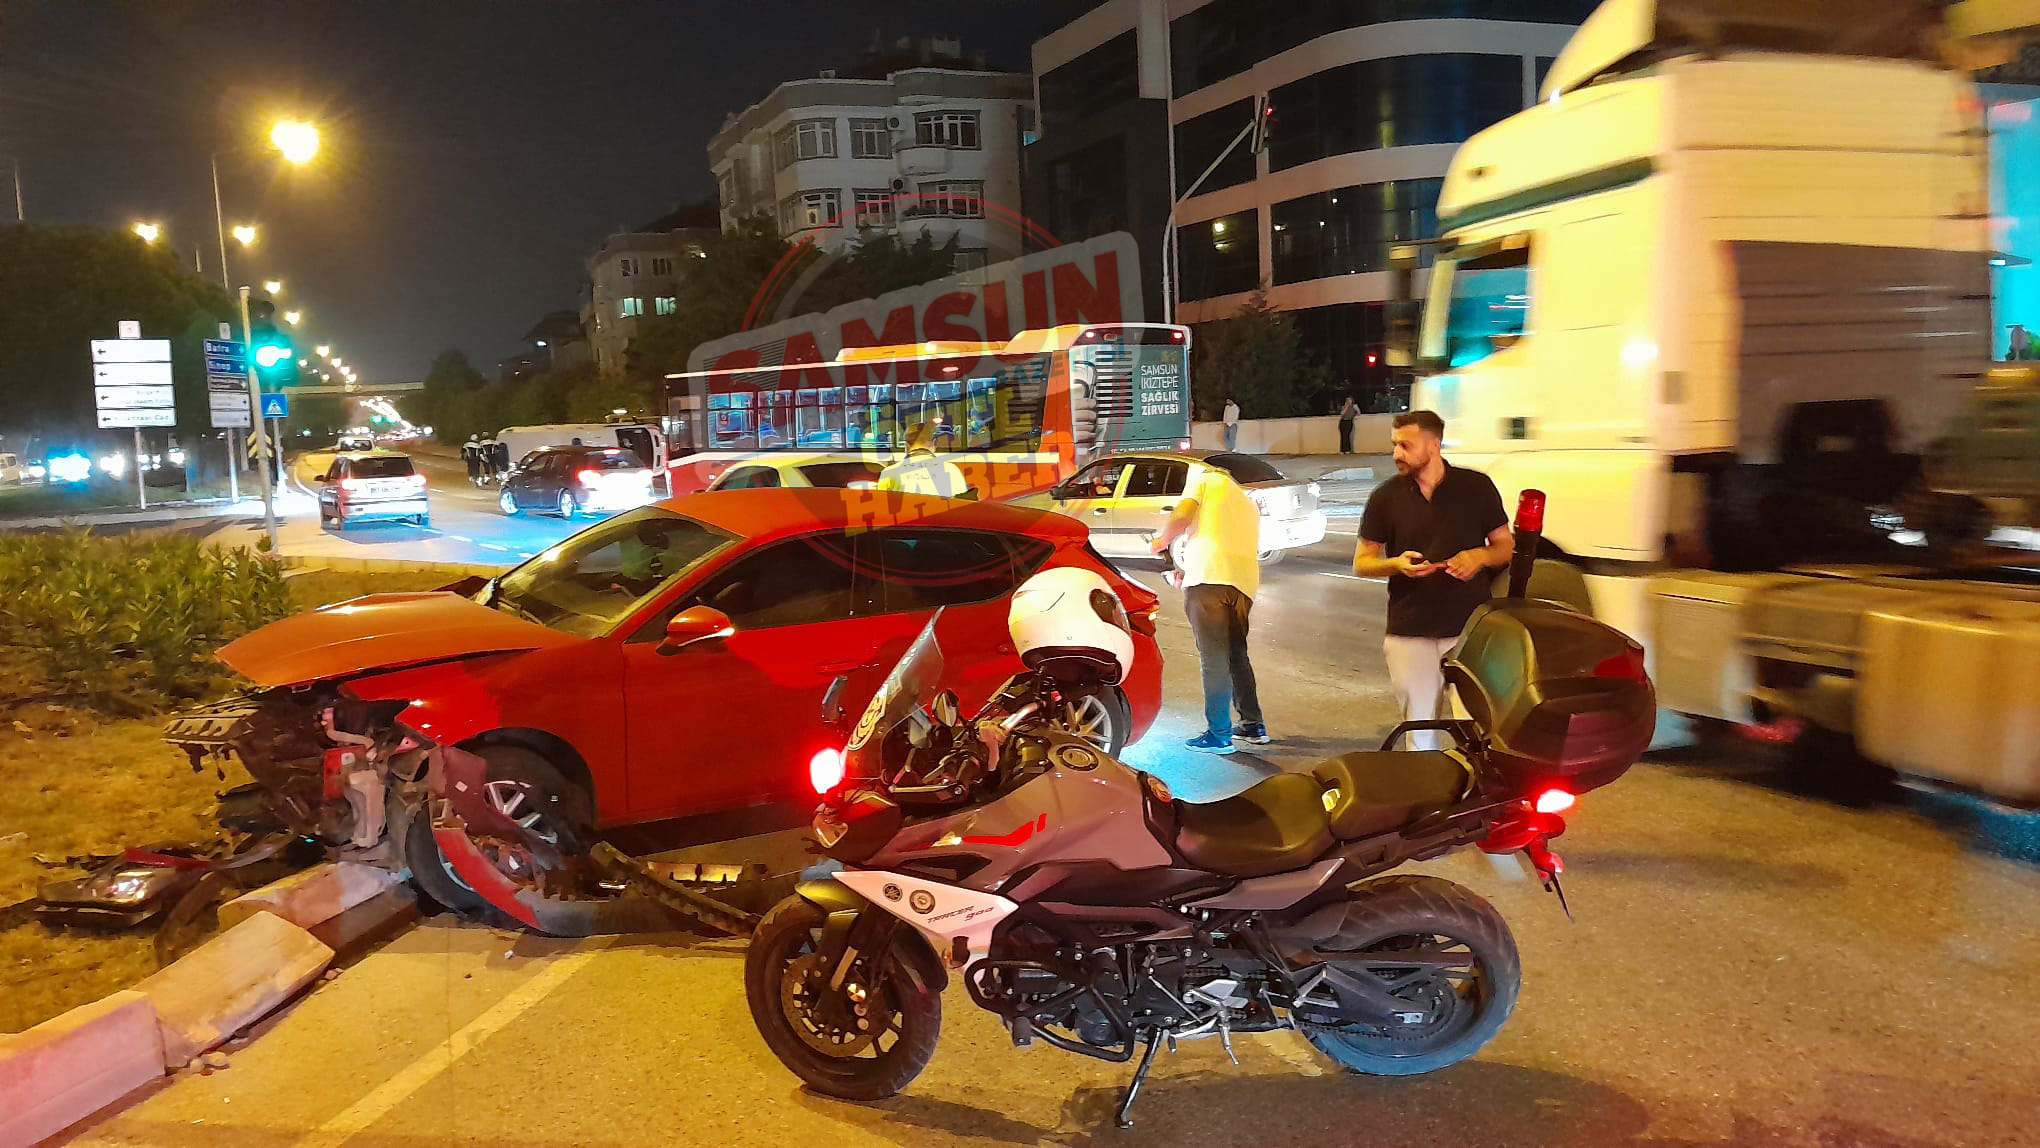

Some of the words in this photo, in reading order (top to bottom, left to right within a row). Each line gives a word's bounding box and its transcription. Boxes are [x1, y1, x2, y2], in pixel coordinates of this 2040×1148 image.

[1140, 363, 1178, 376] SAMSUN
[1140, 390, 1180, 403] SAĞLIK
[1141, 402, 1179, 416] ZİRVESİ
